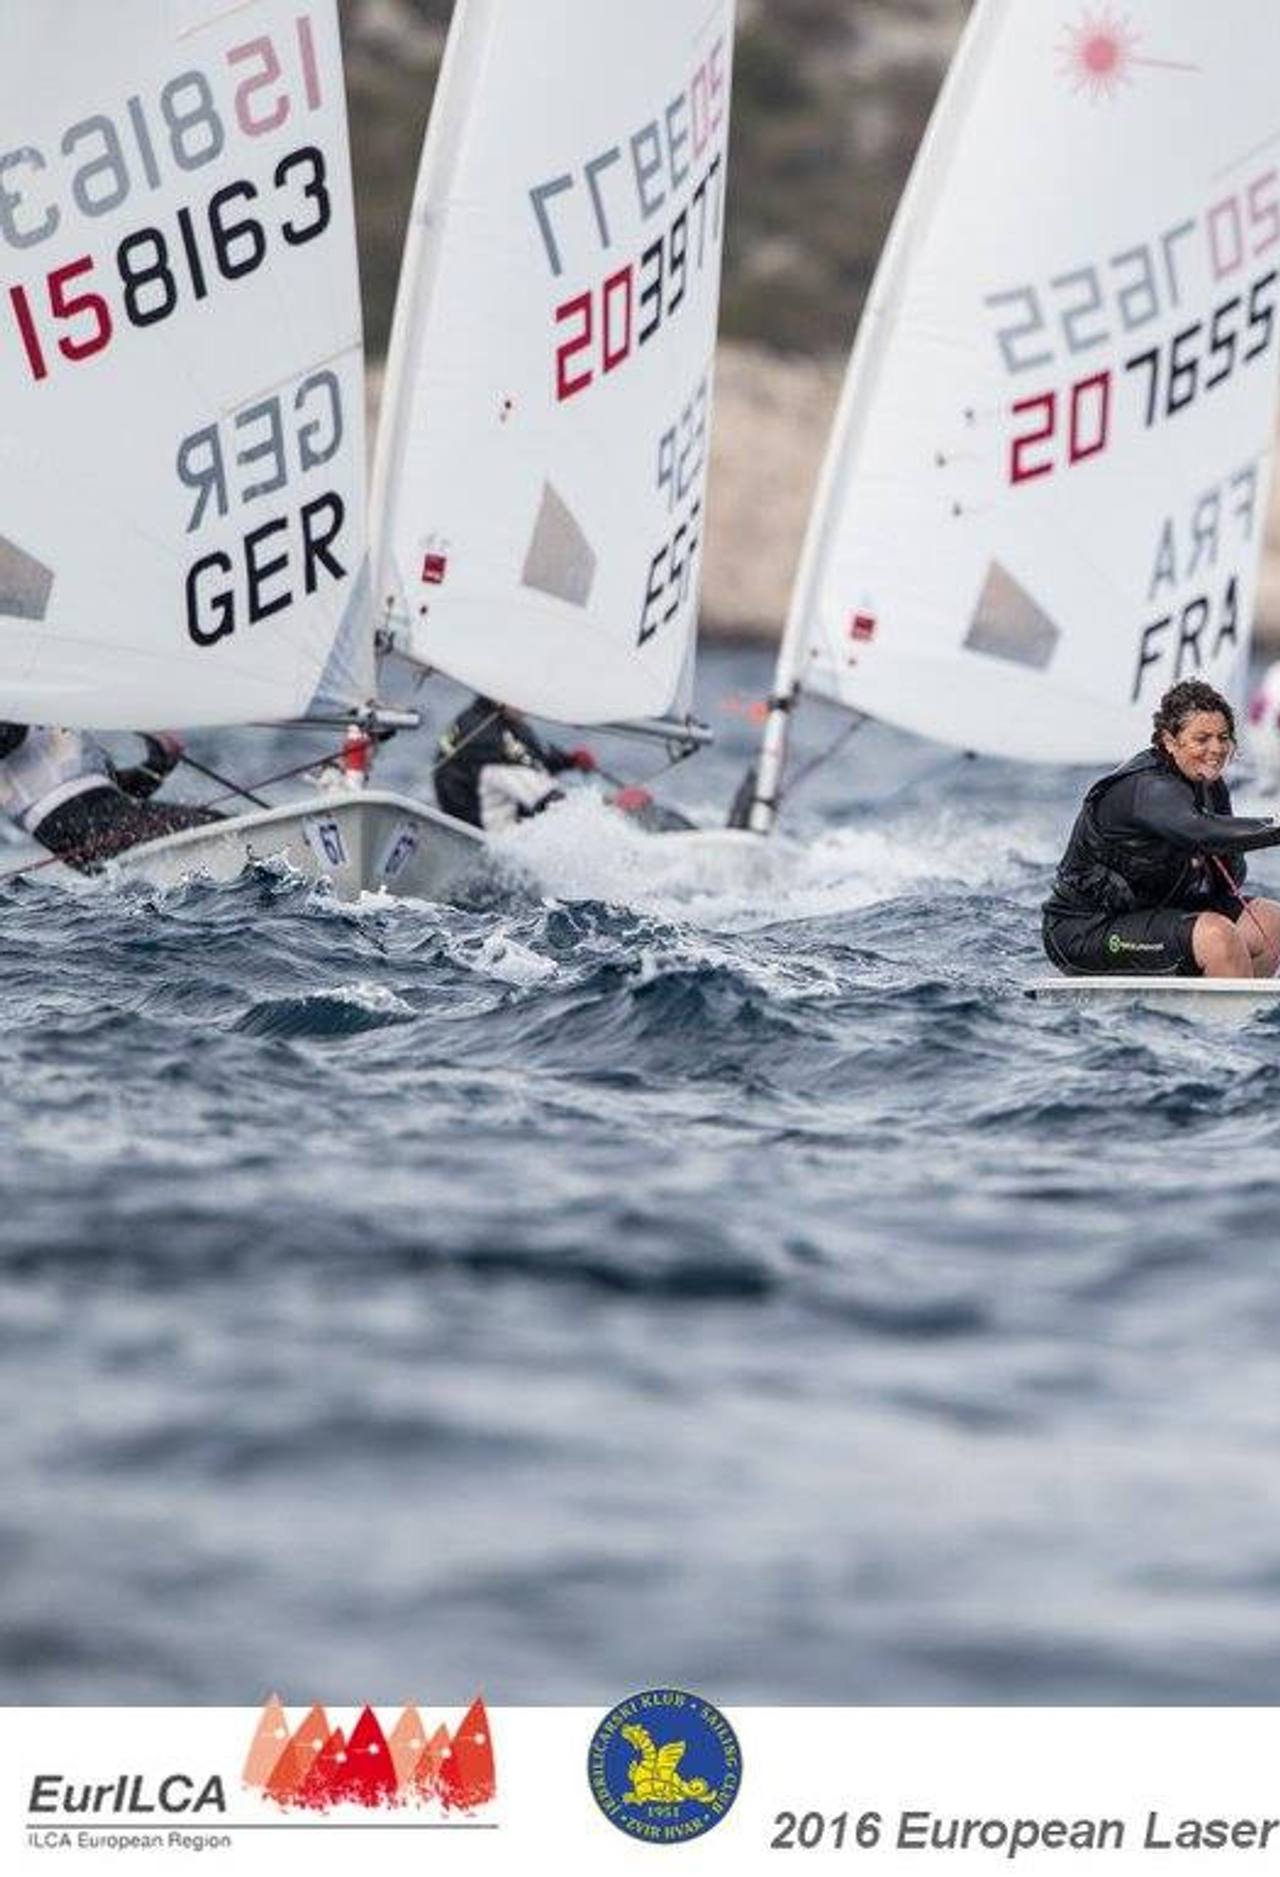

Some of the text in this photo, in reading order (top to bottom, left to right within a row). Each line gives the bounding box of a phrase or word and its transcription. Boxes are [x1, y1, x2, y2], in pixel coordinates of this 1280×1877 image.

[10, 146, 332, 381] 158163
[1010, 270, 1280, 486] 207655
[185, 490, 347, 648] GER
[1132, 576, 1238, 705] FRA
